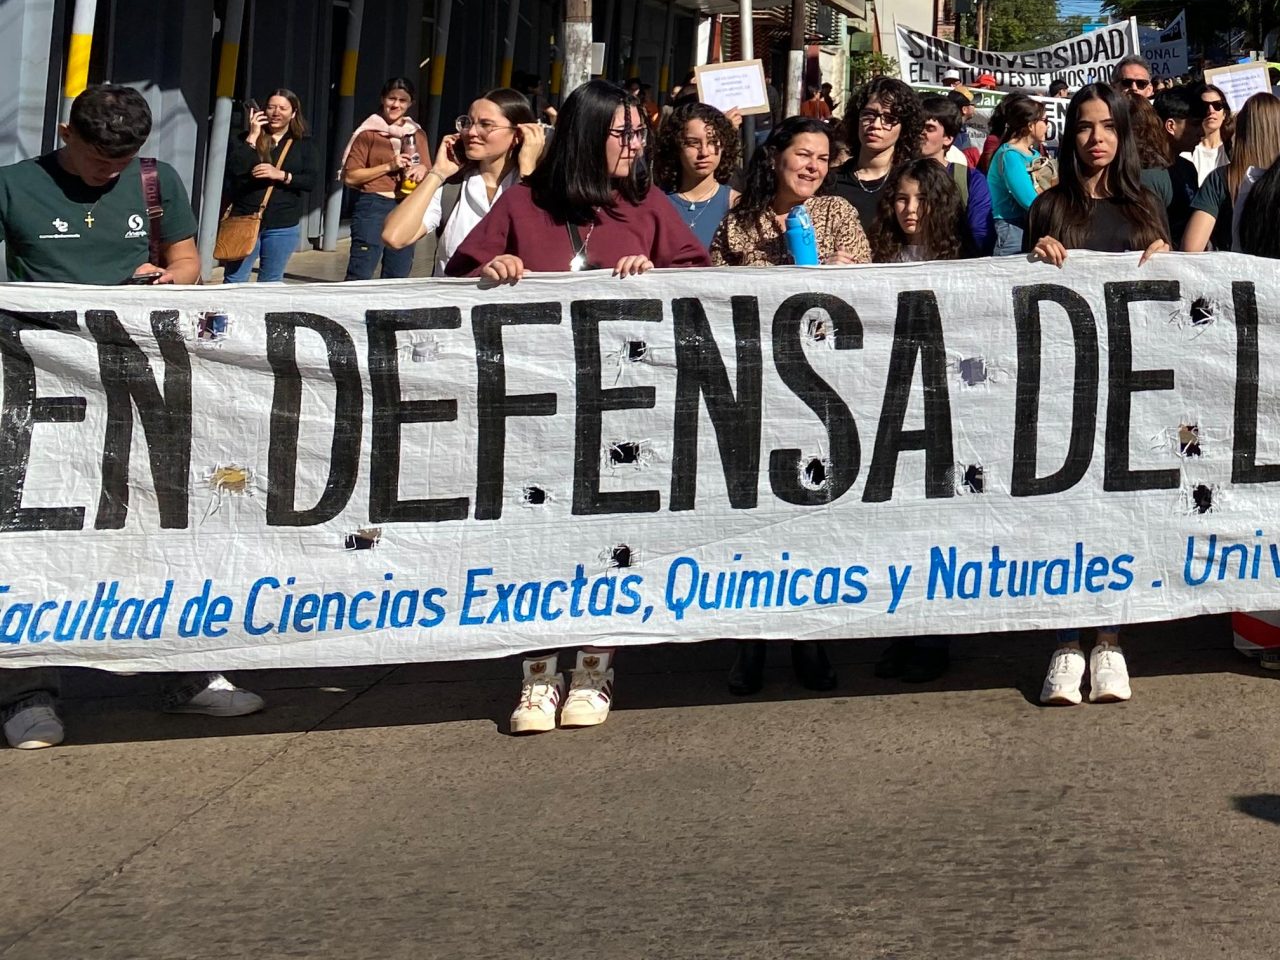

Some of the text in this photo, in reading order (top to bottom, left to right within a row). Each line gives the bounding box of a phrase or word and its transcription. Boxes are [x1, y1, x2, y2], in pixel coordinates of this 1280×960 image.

[907, 29, 949, 63] SIN
[960, 28, 1125, 70] UNIVERSIDAD
[909, 62, 930, 84] EL
[1009, 70, 1026, 88] ES
[1029, 71, 1047, 88] DE
[0, 309, 193, 531] EN
[265, 290, 956, 527] DEFENSA
[1011, 280, 1182, 498] DE
[178, 579, 233, 639] de
[244, 572, 448, 637] Ciencias
[460, 561, 653, 626] Exactas,
[886, 560, 914, 615] y
[926, 541, 1135, 602] Naturales
